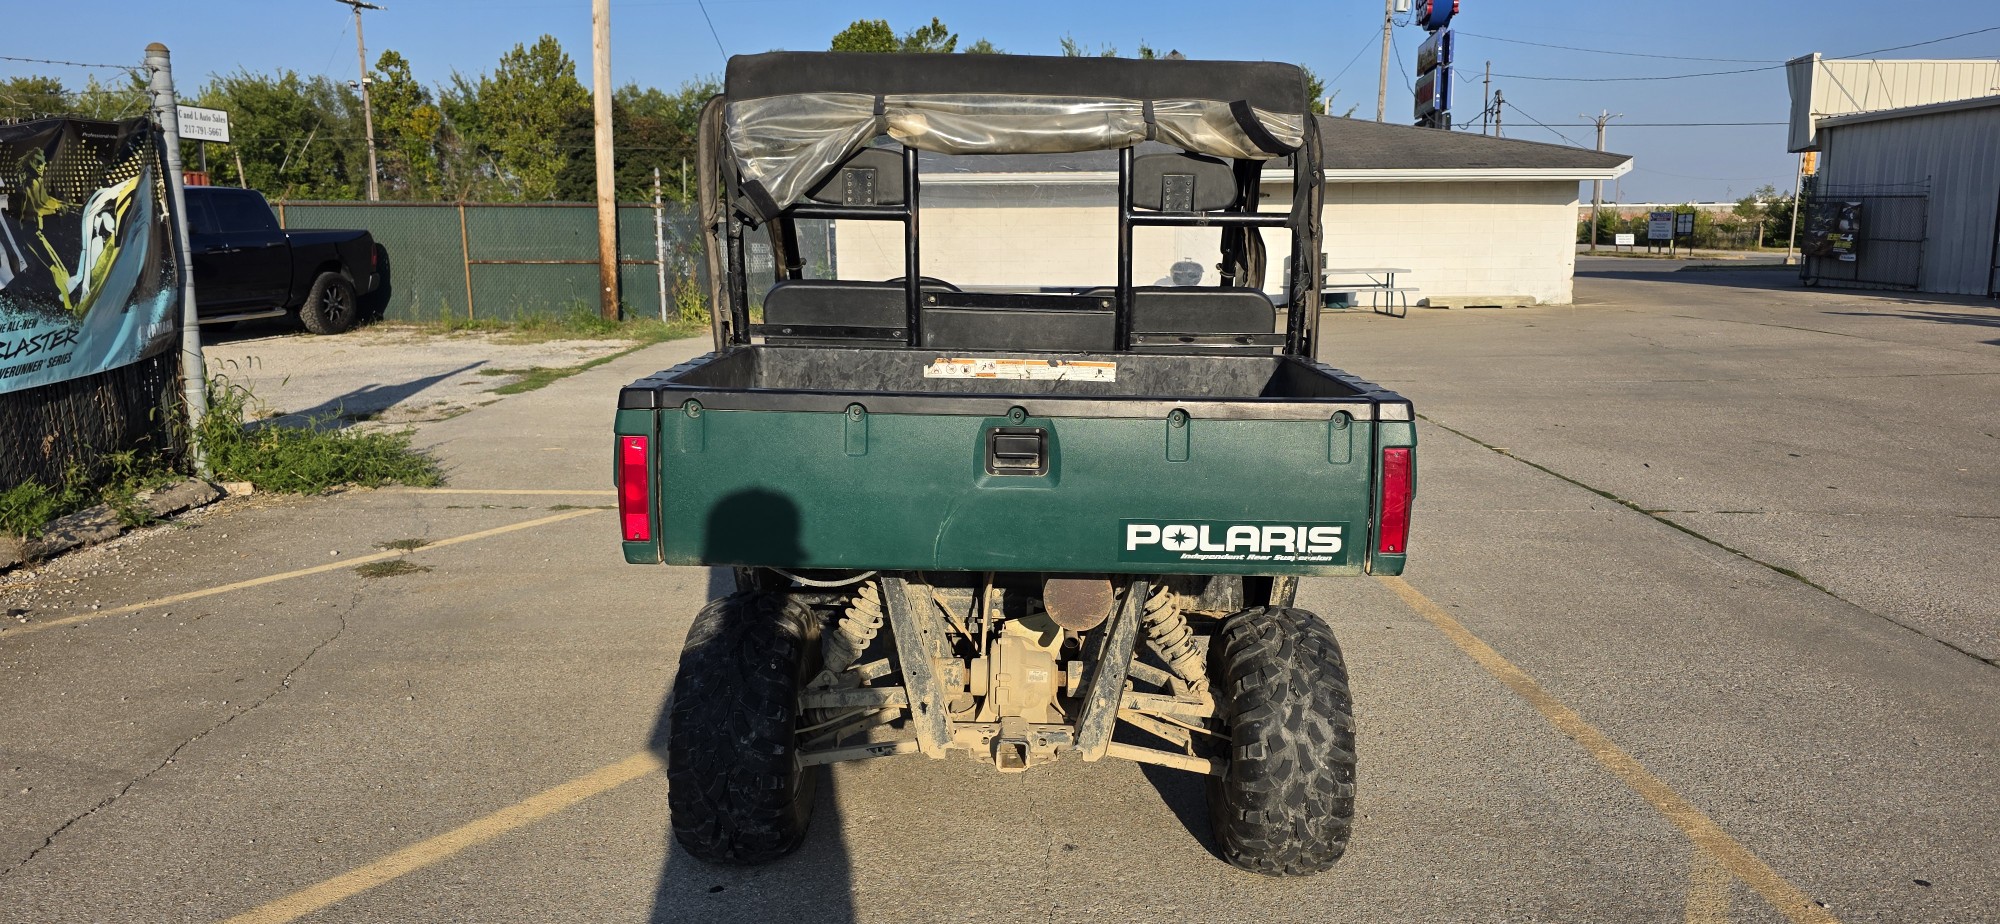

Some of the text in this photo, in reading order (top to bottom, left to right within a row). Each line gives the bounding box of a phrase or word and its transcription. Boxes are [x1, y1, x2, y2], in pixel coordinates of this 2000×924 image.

[178, 109, 226, 124] C and L Auto Sales
[184, 124, 222, 137] 217-791-5667
[7, 319, 38, 332] ALL-NEW
[46, 352, 73, 369] SERIES
[1126, 524, 1342, 553] POLARIS
[1180, 552, 1245, 561] Independent
